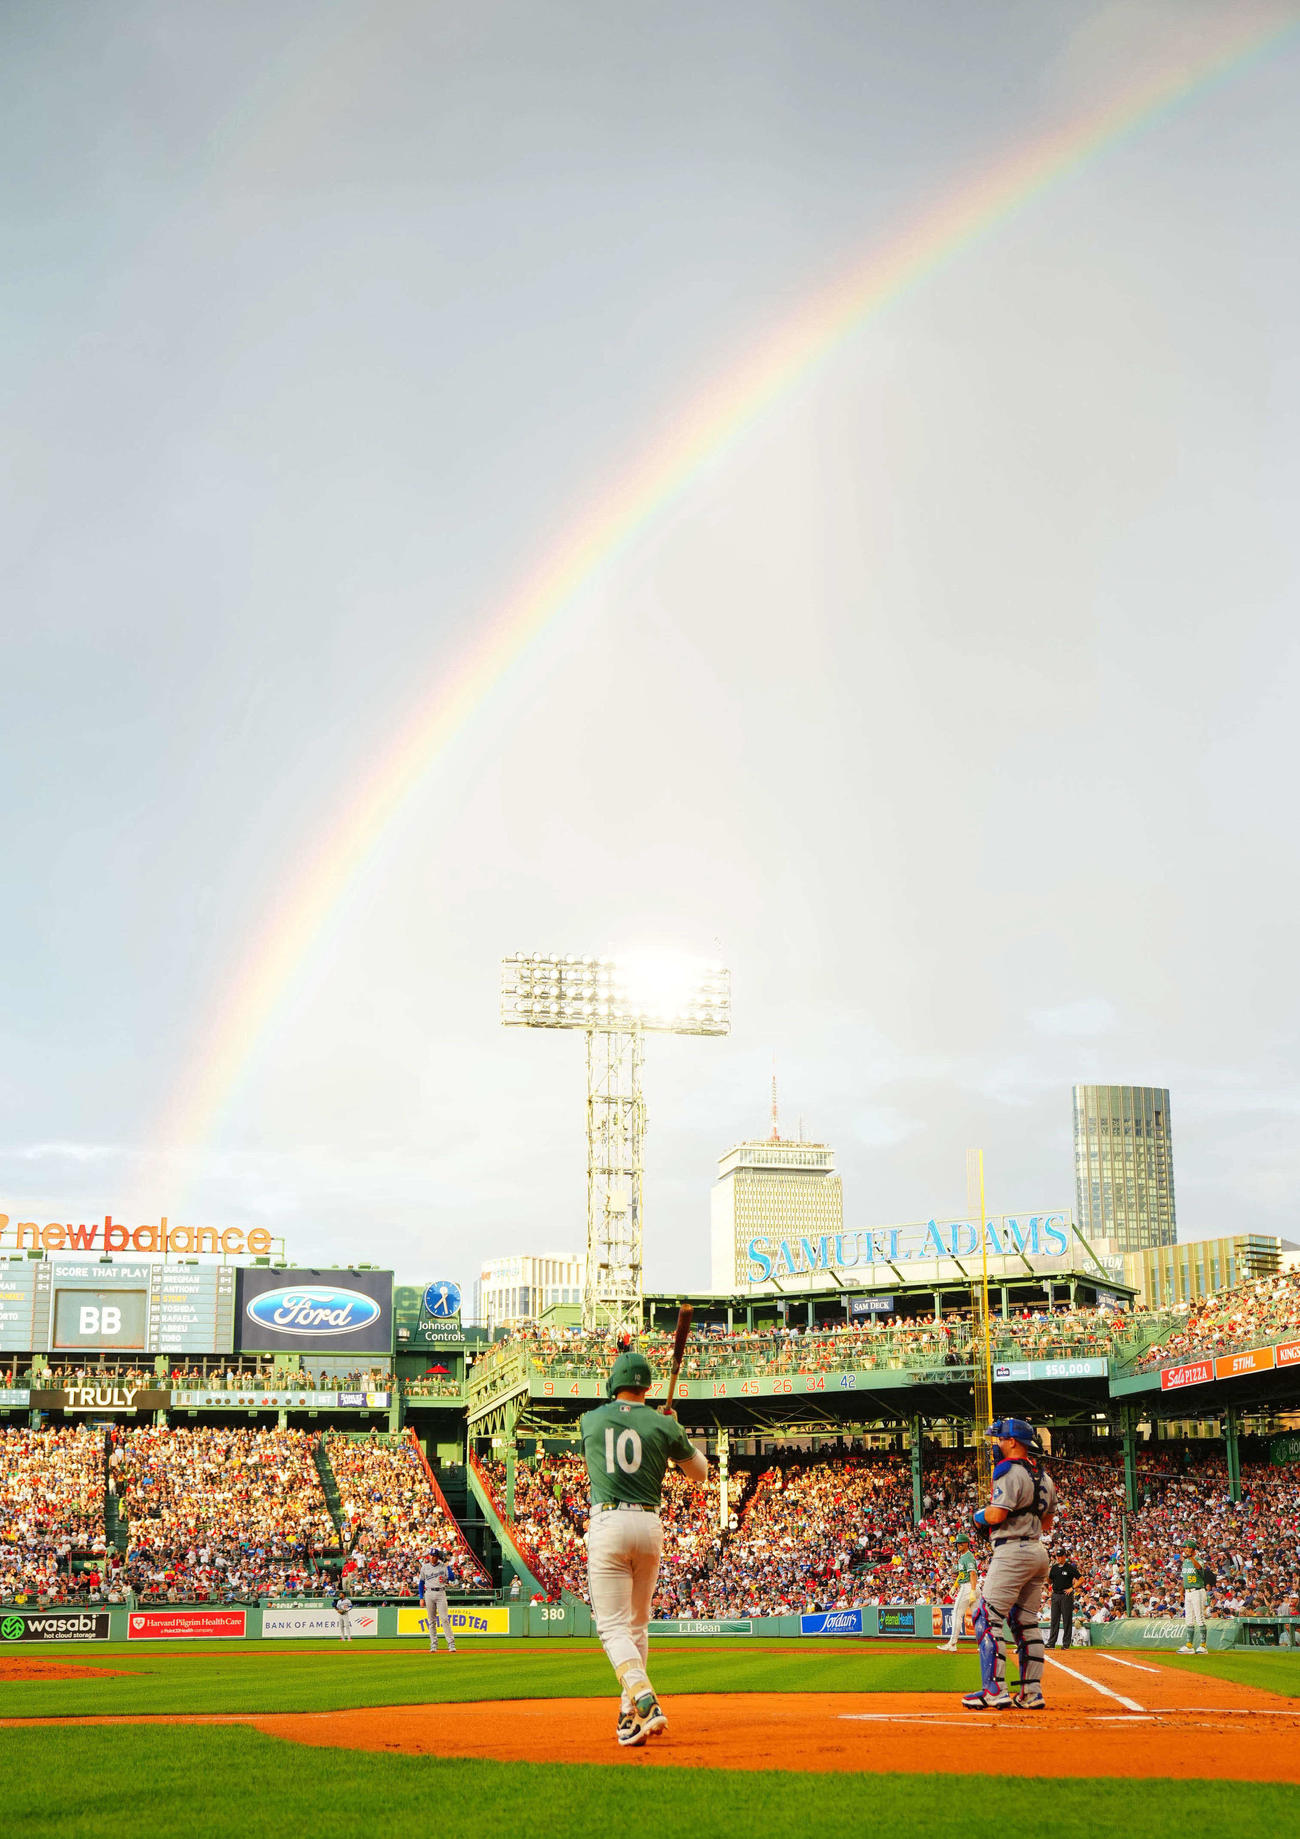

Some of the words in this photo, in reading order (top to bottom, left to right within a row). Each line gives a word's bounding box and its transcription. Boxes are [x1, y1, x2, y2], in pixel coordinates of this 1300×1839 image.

[747, 1229, 911, 1282] SAMUEL
[918, 1215, 1069, 1257] ADAMS
[56, 1267, 89, 1277] SCORE
[92, 1267, 119, 1277] THAT
[121, 1268, 149, 1278] PLAY
[273, 1292, 355, 1326] Ford
[854, 1302, 869, 1311] SAM
[80, 1306, 121, 1335] BB
[418, 1321, 458, 1331] Johnson
[425, 1332, 466, 1341] Controls
[1046, 1363, 1090, 1376] $50,000
[1232, 1355, 1256, 1371] STIHL
[1185, 1366, 1207, 1383] PIZZA
[543, 1382, 554, 1396] 9
[570, 1382, 580, 1396] 4
[594, 1382, 600, 1396] 1
[678, 1383, 689, 1397] 6
[713, 1383, 727, 1397] 14
[740, 1380, 760, 1395] 45
[772, 1379, 793, 1393] 26
[806, 1376, 825, 1391] 34
[840, 1374, 856, 1389] 42
[64, 1387, 138, 1406] TRULY
[605, 1427, 642, 1474] 10
[147, 1618, 175, 1626] Harvard
[176, 1618, 201, 1628] Pilgrim
[202, 1617, 225, 1626] Health
[226, 1617, 242, 1625] Care
[541, 1608, 565, 1620] 380
[27, 1614, 97, 1632] wasabi
[265, 1621, 292, 1629] BANK
[294, 1621, 306, 1629] OF
[309, 1620, 352, 1629] AMERIA
[469, 1615, 488, 1632] TEA
[819, 1613, 857, 1633] Jordan's
